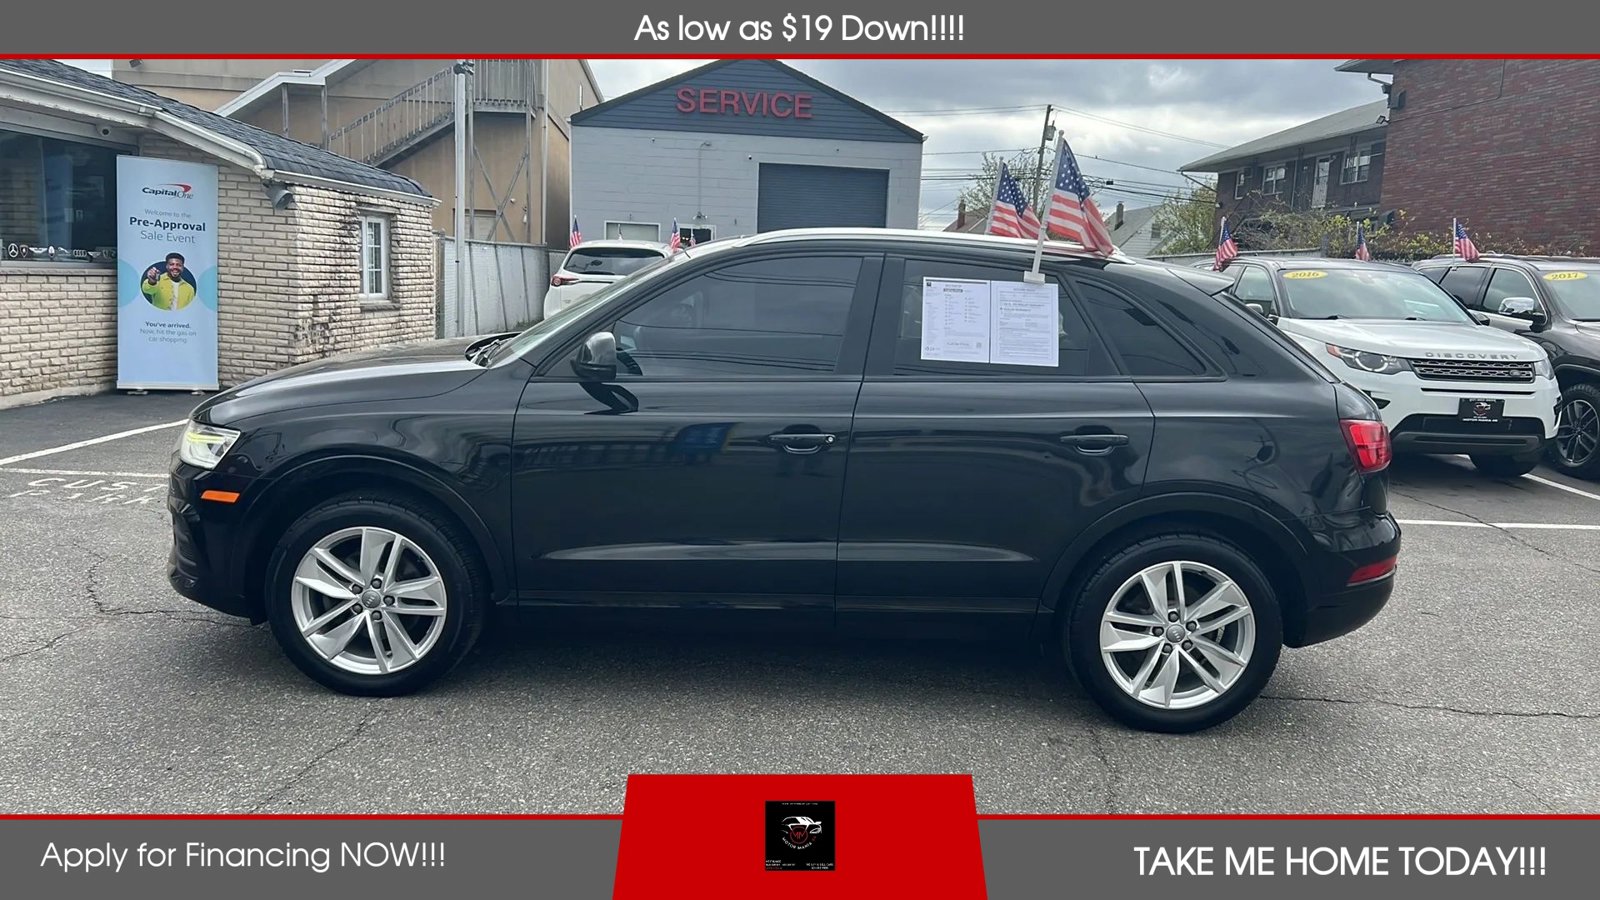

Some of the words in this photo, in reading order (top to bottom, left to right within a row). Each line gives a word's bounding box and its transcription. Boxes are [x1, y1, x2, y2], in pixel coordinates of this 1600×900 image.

[676, 87, 814, 119] SERVICE
[144, 209, 172, 217] Welcome
[129, 216, 206, 232] Pre-Approval
[140, 230, 164, 241] Sale
[167, 232, 196, 244] Event
[1551, 272, 1578, 280] 2017
[1425, 352, 1519, 360] DISCOVERY
